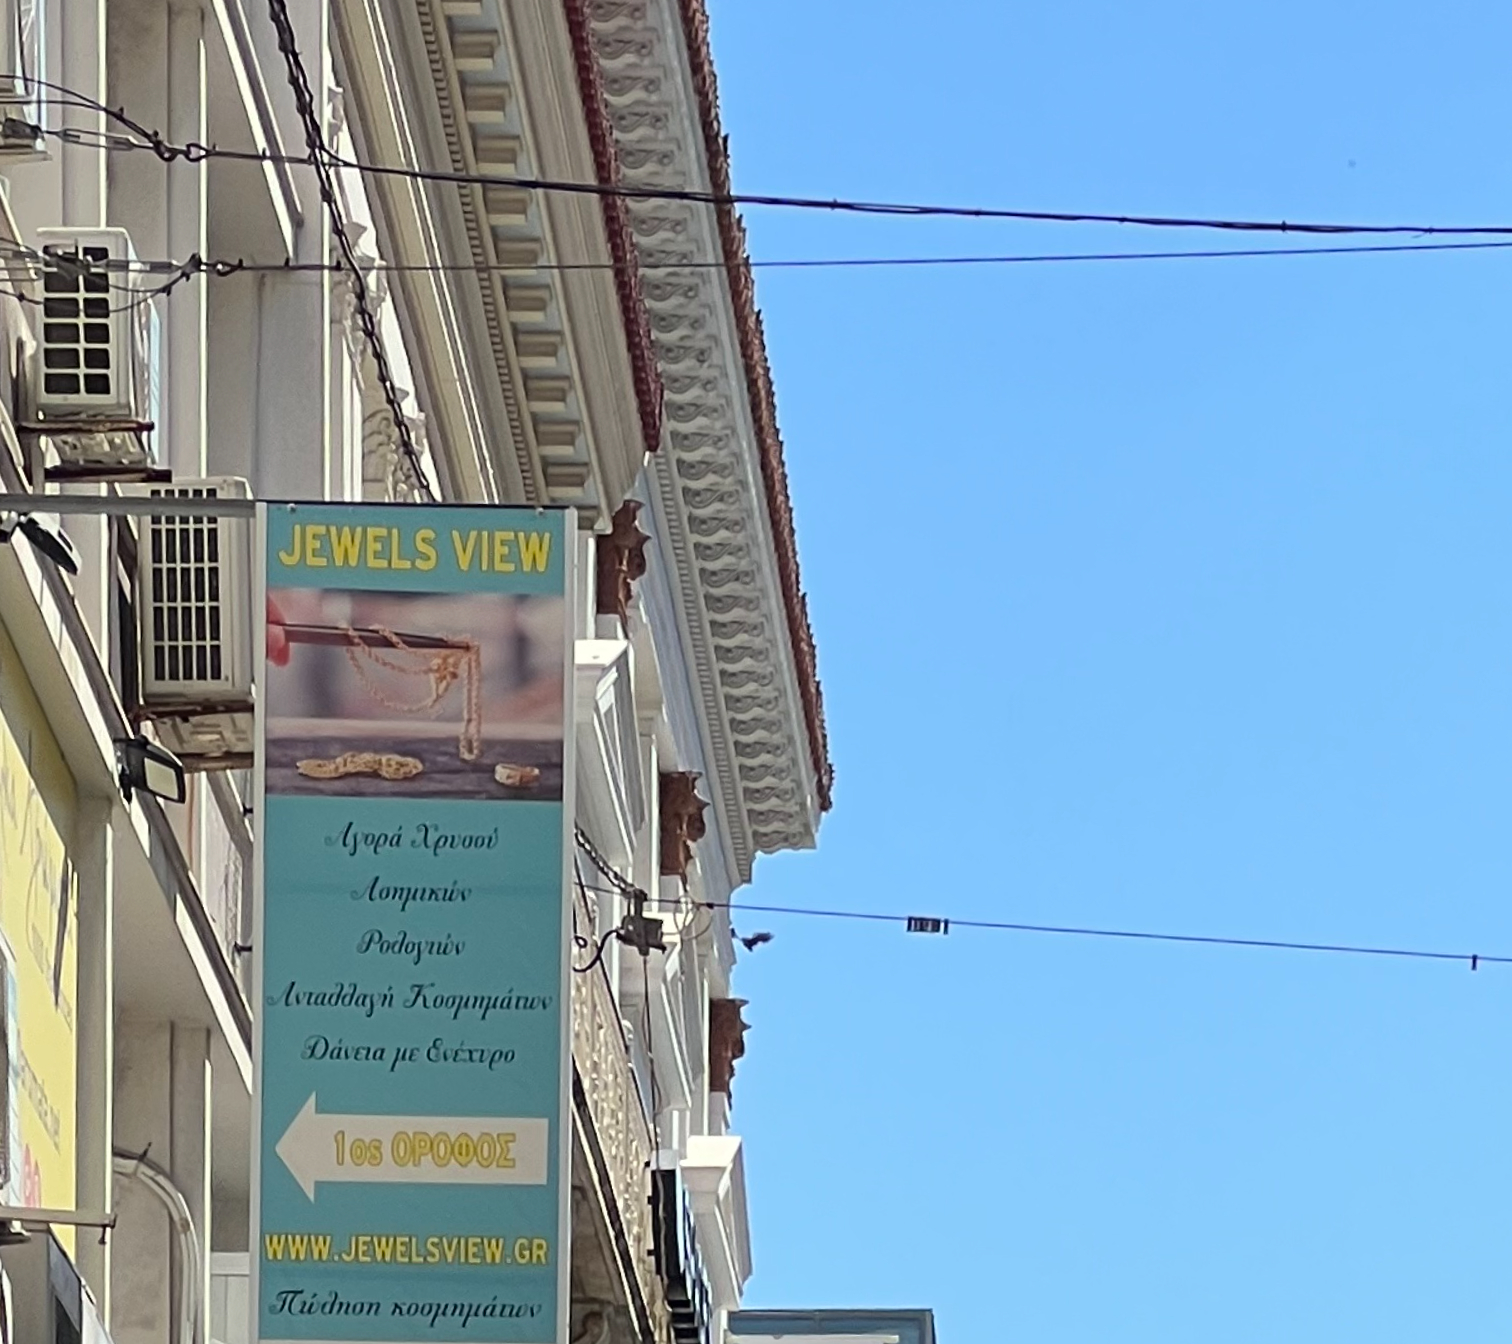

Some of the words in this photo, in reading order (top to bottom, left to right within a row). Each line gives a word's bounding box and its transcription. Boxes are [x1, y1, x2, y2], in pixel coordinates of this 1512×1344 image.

[279, 525, 437, 571] JEWELS
[451, 530, 551, 572] VIEW
[324, 822, 402, 856] Αγορά
[411, 823, 498, 856] Χρυσού
[351, 876, 471, 911] Ασημικών
[356, 929, 465, 966] Ρολογιών
[267, 981, 394, 1018] Ανταλλαγή
[402, 983, 552, 1020] Κοσμημάτων
[390, 1048, 421, 1072] με
[426, 1038, 515, 1071] Ενέχυρο
[391, 1131, 516, 1168] ΟΡΟΦΟΣ
[264, 1233, 548, 1265] WWW.JEWELSVIEW.GR
[269, 1289, 380, 1317] Πώληση
